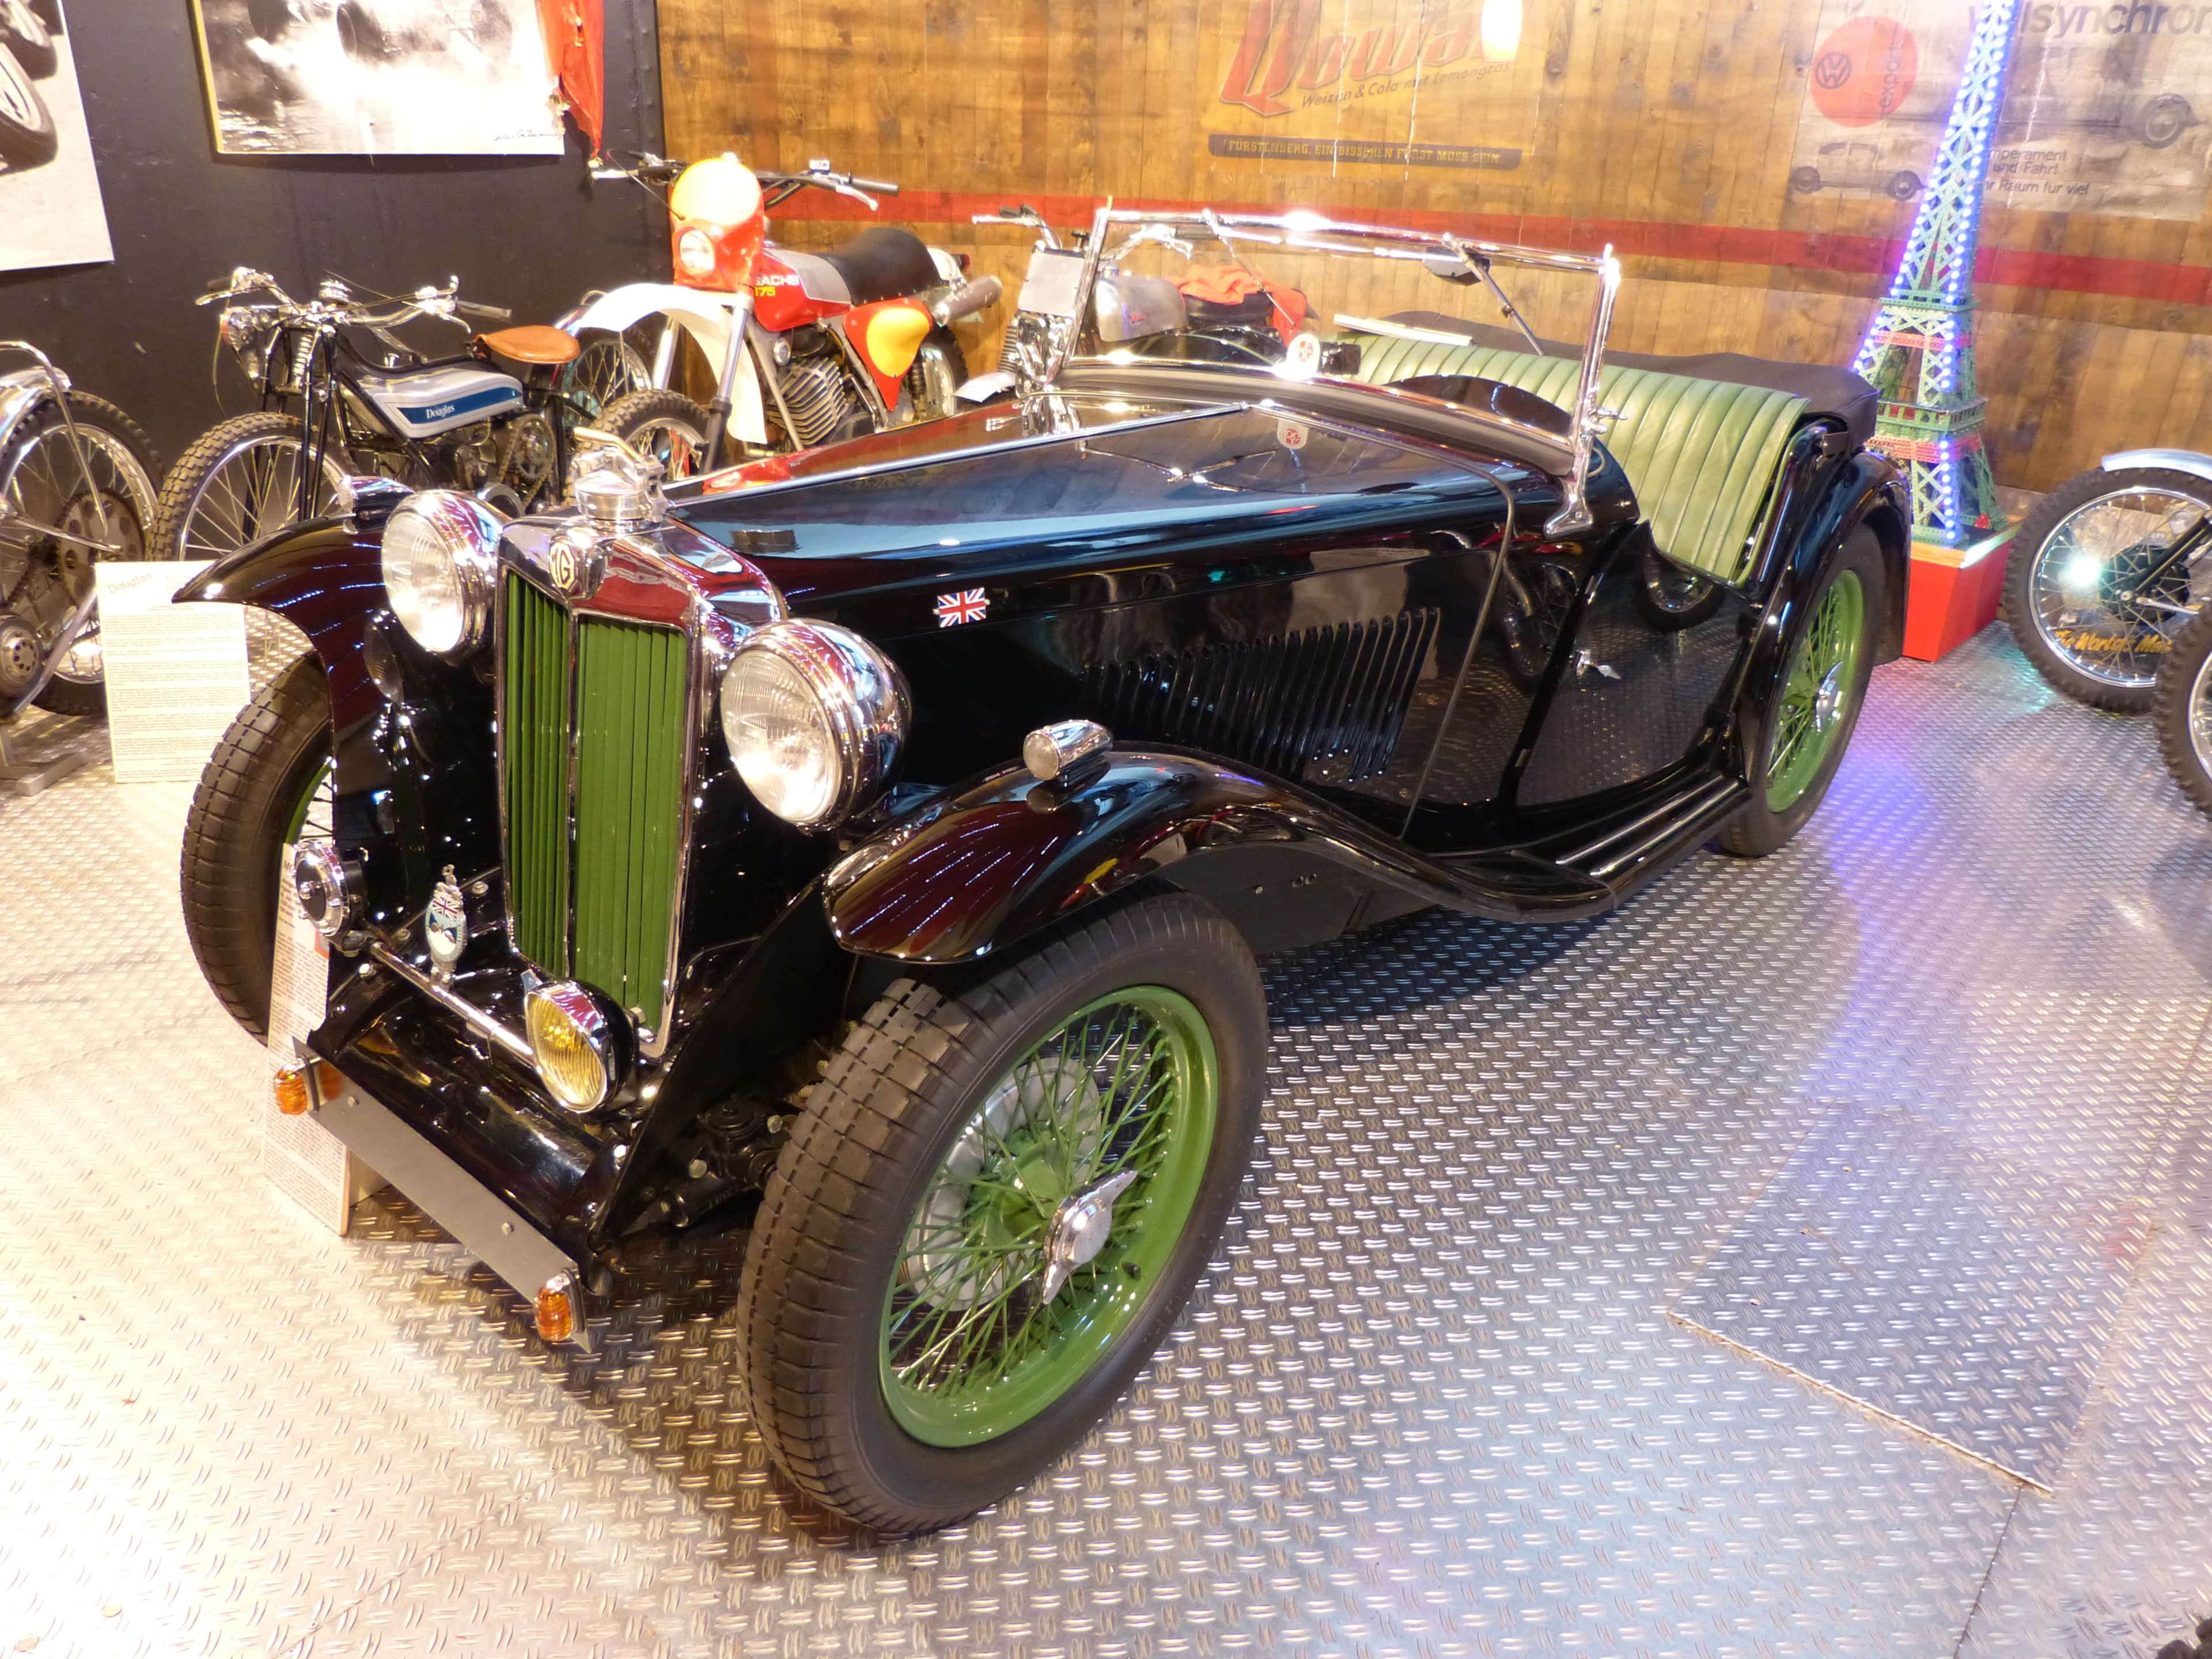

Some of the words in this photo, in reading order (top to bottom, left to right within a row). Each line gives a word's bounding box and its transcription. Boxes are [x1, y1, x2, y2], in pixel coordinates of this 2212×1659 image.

[1219, 0, 1505, 117] Qowa
[1302, 91, 1351, 108] Weizen
[1354, 85, 1365, 99] &
[1368, 80, 1399, 96] Cola
[755, 286, 776, 297] 175
[426, 404, 454, 419] Douglas
[550, 546, 572, 586] MG
[107, 572, 154, 594] Douglas
